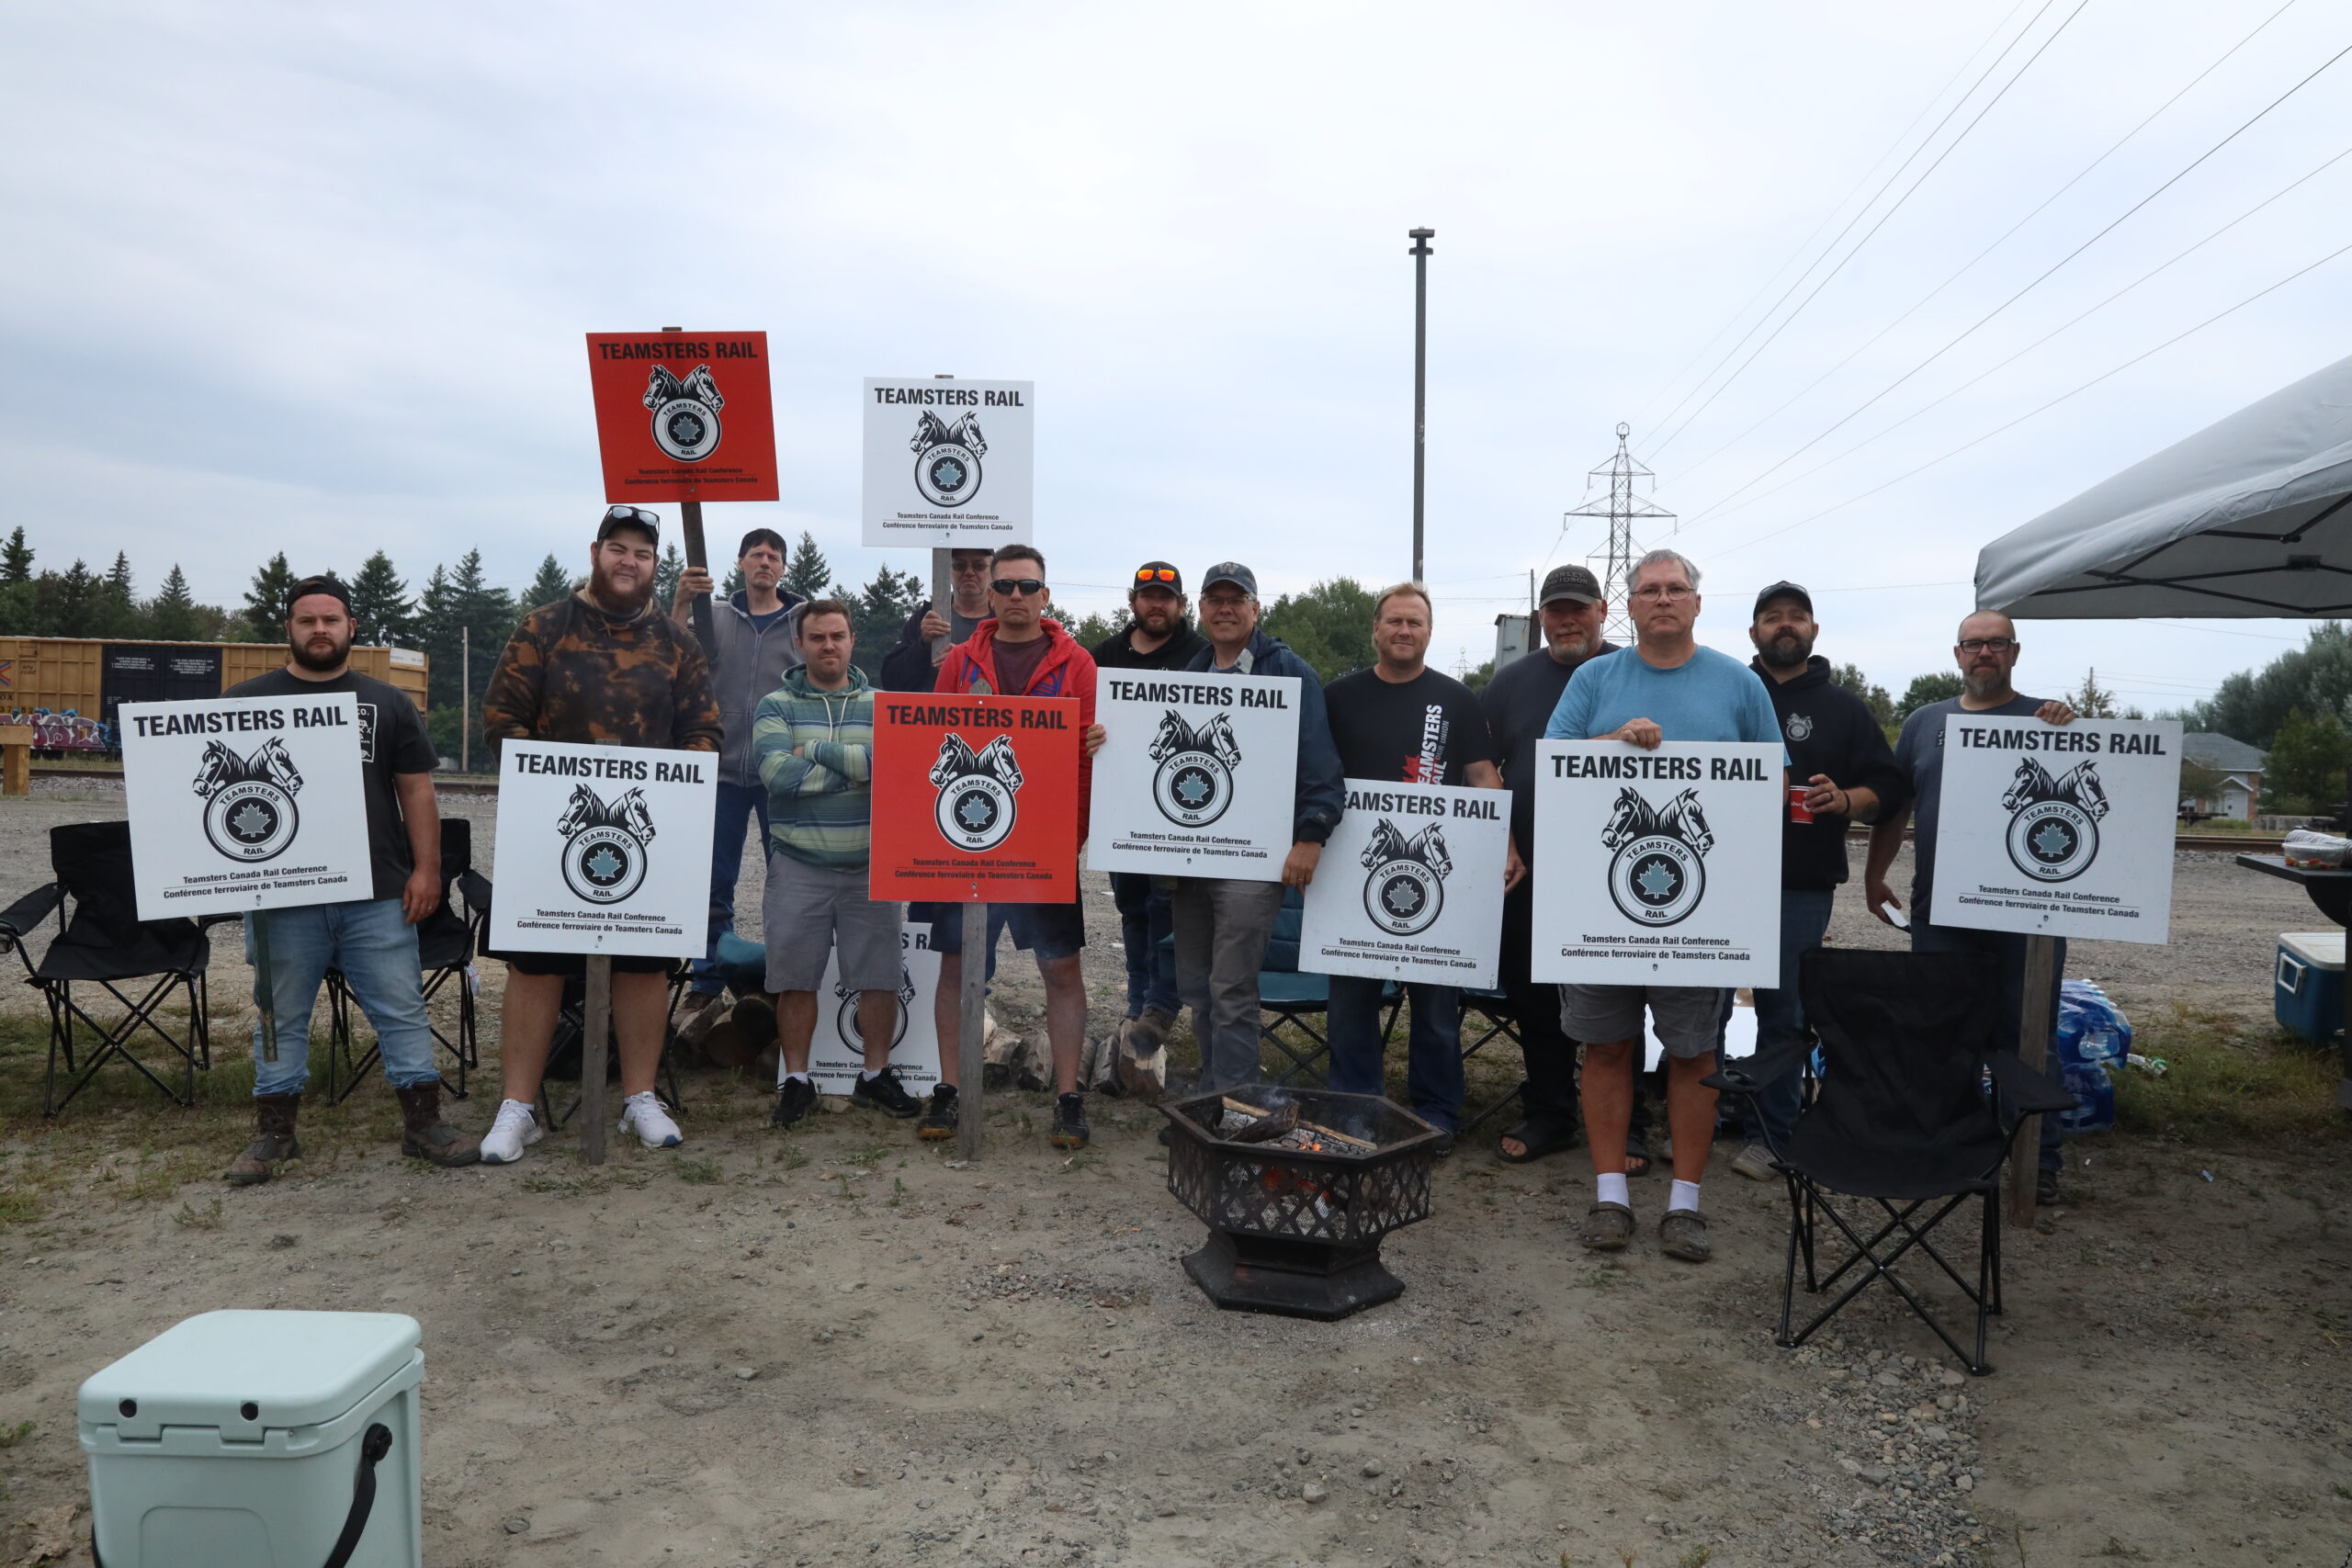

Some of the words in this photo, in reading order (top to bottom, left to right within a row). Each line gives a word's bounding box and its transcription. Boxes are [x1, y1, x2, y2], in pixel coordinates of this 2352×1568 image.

[598, 342, 709, 360] TEAMSTERS
[716, 342, 758, 358] RAIL
[874, 388, 978, 406] TEAMSTERS
[985, 390, 1024, 407] RAIL
[663, 402, 707, 416] TEAMSTERS
[927, 447, 970, 462] TEAMSTERS
[1218, 563, 1239, 575] W
[1109, 681, 1233, 706] TEAMSTERS
[1240, 688, 1288, 709] RAIL
[133, 709, 285, 737] TEAMSTERS
[292, 705, 348, 728] RAIL
[887, 705, 1013, 728] TEAMSTERS
[1021, 709, 1068, 729] RAIL
[1440, 720, 1450, 744] UNION
[1417, 705, 1442, 784] EAMSTERS
[1960, 728, 2101, 753] TEAMSTERS
[2109, 733, 2166, 756] RAIL
[515, 753, 648, 781] TEAMSTERS
[655, 761, 705, 784] RAIL
[1168, 756, 1220, 773] TEAMSTERS
[1431, 761, 1447, 785] AIL
[1551, 755, 1702, 781] TEAMSTERS
[1711, 758, 1769, 781] RAIL
[219, 786, 280, 805] TEAMSTERS
[951, 779, 1001, 796] TEAMSTERS
[1453, 798, 1500, 820] RAIL
[2024, 806, 2084, 825] TEAMSTERS
[578, 831, 633, 850] TEAMSTERS
[1130, 831, 1166, 840] Teamsters
[1168, 833, 1194, 842] Canada
[1195, 835, 1210, 843] Rail
[1211, 836, 1251, 846] Conference
[243, 847, 266, 855] RAIL
[1112, 842, 1152, 852] Conférence
[1153, 844, 1191, 854] ferroviaire
[1203, 847, 1239, 857] Teamsters
[1240, 850, 1268, 859] Canada
[1626, 841, 1689, 862] TEAMSTERS
[913, 857, 951, 866] Teamsters
[952, 858, 979, 867] Canada
[980, 859, 995, 867] Rail
[995, 859, 1035, 868] Conference
[2039, 865, 2061, 874] RAIL
[183, 874, 228, 884] Teamsters
[230, 871, 261, 880] Canada
[263, 868, 279, 877] Rail
[281, 865, 327, 875] Conference
[897, 869, 938, 878] Conférence
[938, 869, 976, 879] ferroviaire
[977, 870, 987, 879] de
[987, 870, 1024, 880] Teamsters
[1024, 871, 1052, 880] Canada
[1379, 864, 1430, 883] TEAMSTERS
[164, 888, 212, 899] Conférence
[214, 884, 258, 894] ferroviaire
[260, 882, 271, 890] de
[273, 879, 316, 888] Teamsters
[317, 875, 347, 885] Canada
[593, 888, 613, 897] RAIL
[1978, 885, 2020, 896] Teamsters
[2021, 888, 2052, 898] Canada
[2054, 891, 2071, 899] Rail
[2073, 892, 2120, 904] Conference
[537, 908, 575, 918] Teamsters
[577, 910, 605, 919] Canada
[624, 913, 666, 922] Conference
[1645, 908, 1668, 919] RAIL
[1959, 896, 2004, 907] Conférence
[2005, 899, 2048, 910] ferroviaire
[2062, 904, 2106, 916] Teamsters
[2108, 908, 2140, 919] Canada
[517, 920, 560, 930] Conférence
[561, 922, 602, 931] ferroviaire
[615, 924, 653, 933] Teamsters
[655, 926, 683, 935] Canada
[1391, 920, 1410, 929] RAIL
[1339, 937, 1375, 948] Teamsters
[1376, 941, 1403, 951] Canada
[1405, 943, 1419, 952] Rail
[1420, 945, 1461, 955] Conference
[1582, 934, 1626, 943] Teamsters
[1628, 935, 1660, 944] Canada
[1663, 936, 1679, 945] Rail
[1681, 936, 1730, 946] Conference
[1321, 948, 1361, 958] Conférence
[1362, 952, 1399, 962] ferroviaire
[1411, 956, 1448, 966] Teamsters
[1450, 959, 1476, 969] Canada
[1561, 948, 1610, 958] Conférence
[1611, 949, 1657, 959] ferroviaire
[1658, 951, 1669, 959] de
[1671, 951, 1716, 960] Teamsters
[1718, 952, 1750, 961] Canada
[816, 1060, 848, 1068] Teamsters
